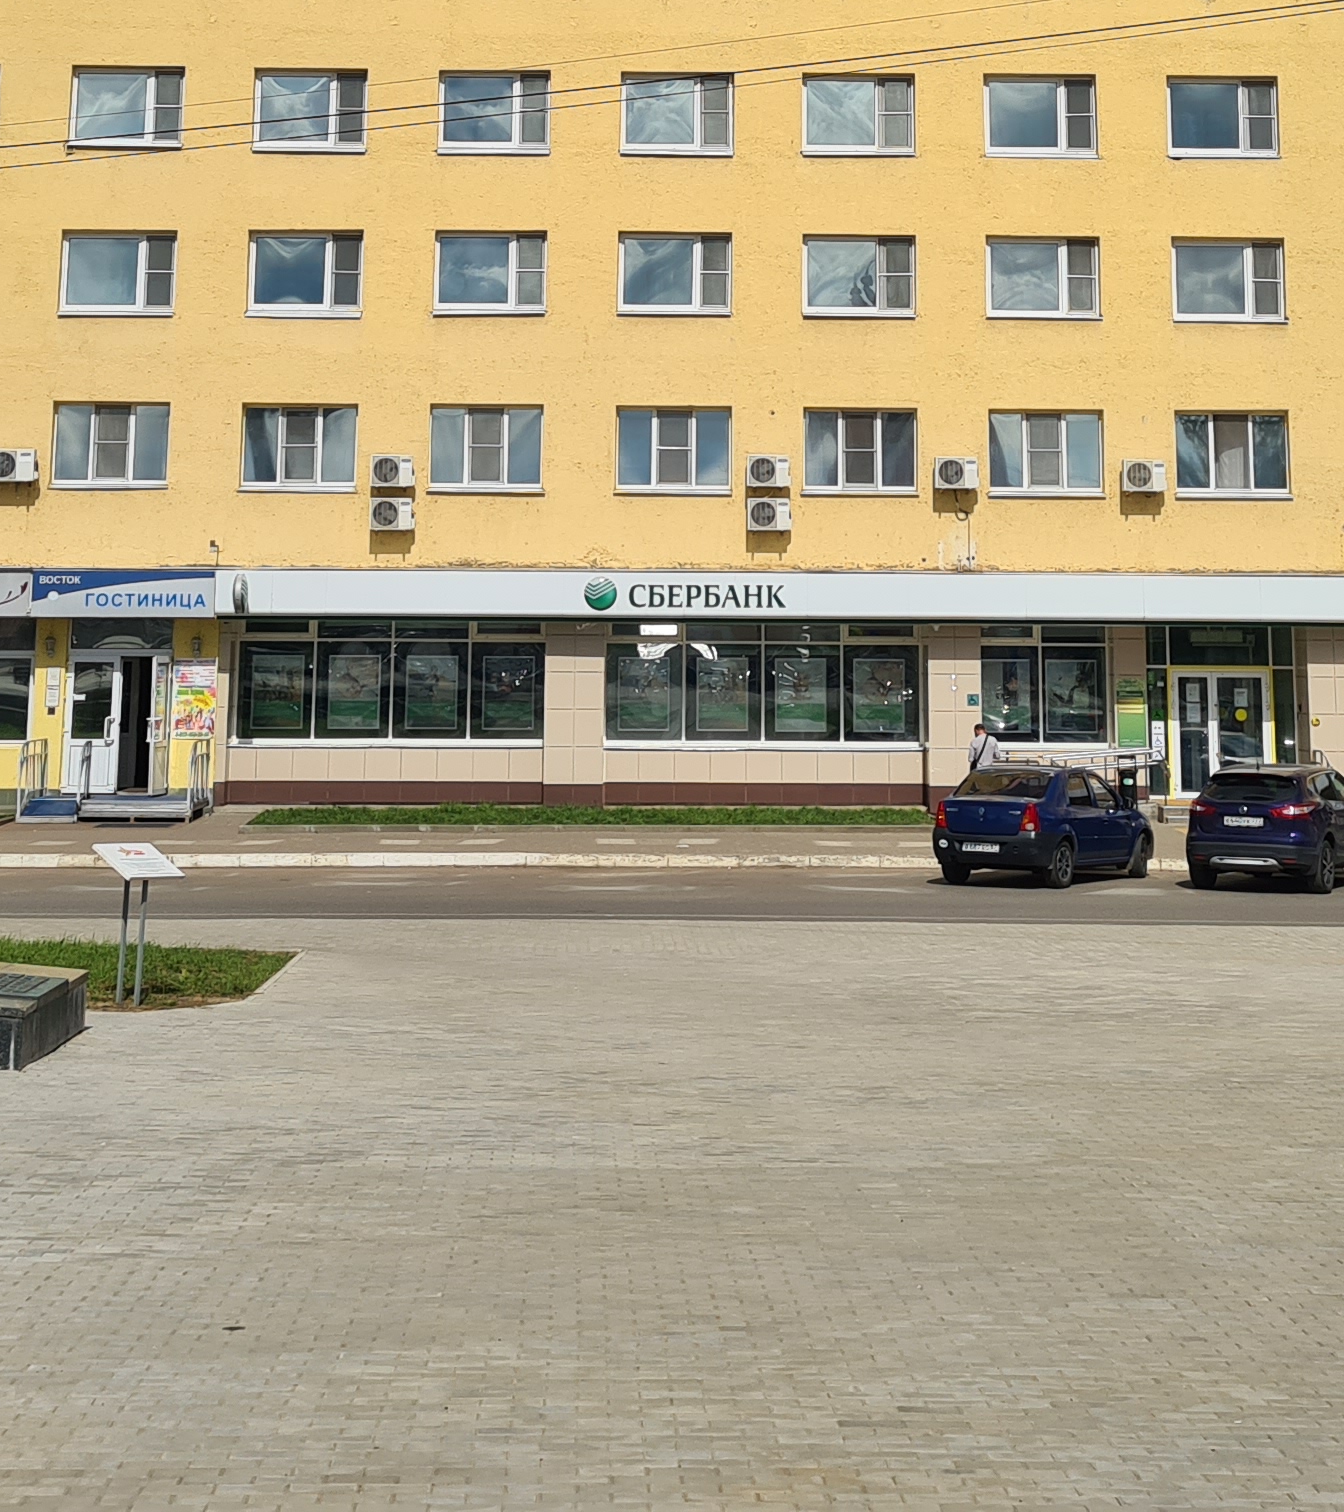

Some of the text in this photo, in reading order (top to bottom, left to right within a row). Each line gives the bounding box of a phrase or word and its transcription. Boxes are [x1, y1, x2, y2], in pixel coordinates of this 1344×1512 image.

[39, 575, 81, 585] ВОСТОК
[85, 592, 207, 610] ГОСТИНИЦА
[629, 583, 787, 609] СБЕРБАНК
